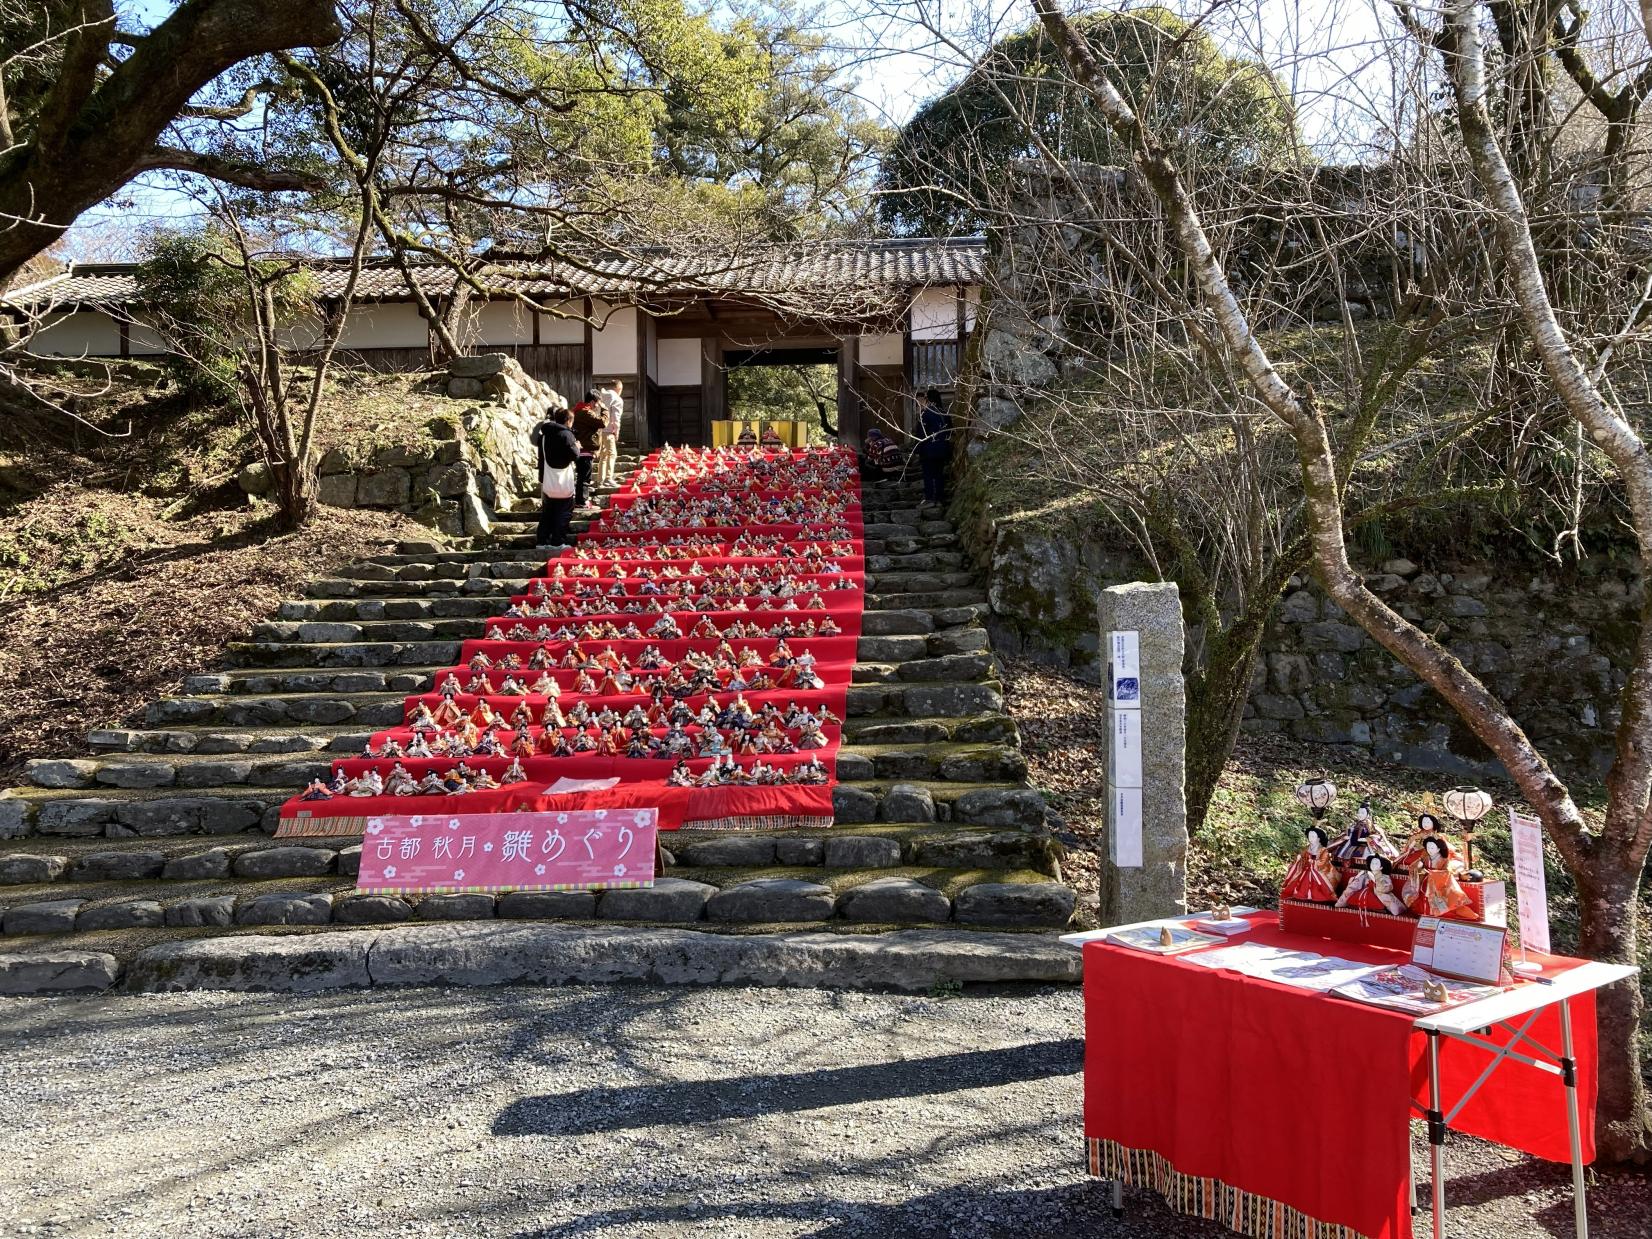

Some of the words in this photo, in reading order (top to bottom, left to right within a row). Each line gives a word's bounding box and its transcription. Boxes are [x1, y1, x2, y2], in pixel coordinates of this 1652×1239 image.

[376, 837, 420, 860] 古都
[431, 835, 477, 860] 秋月
[500, 826, 634, 863] 雛めぐり
